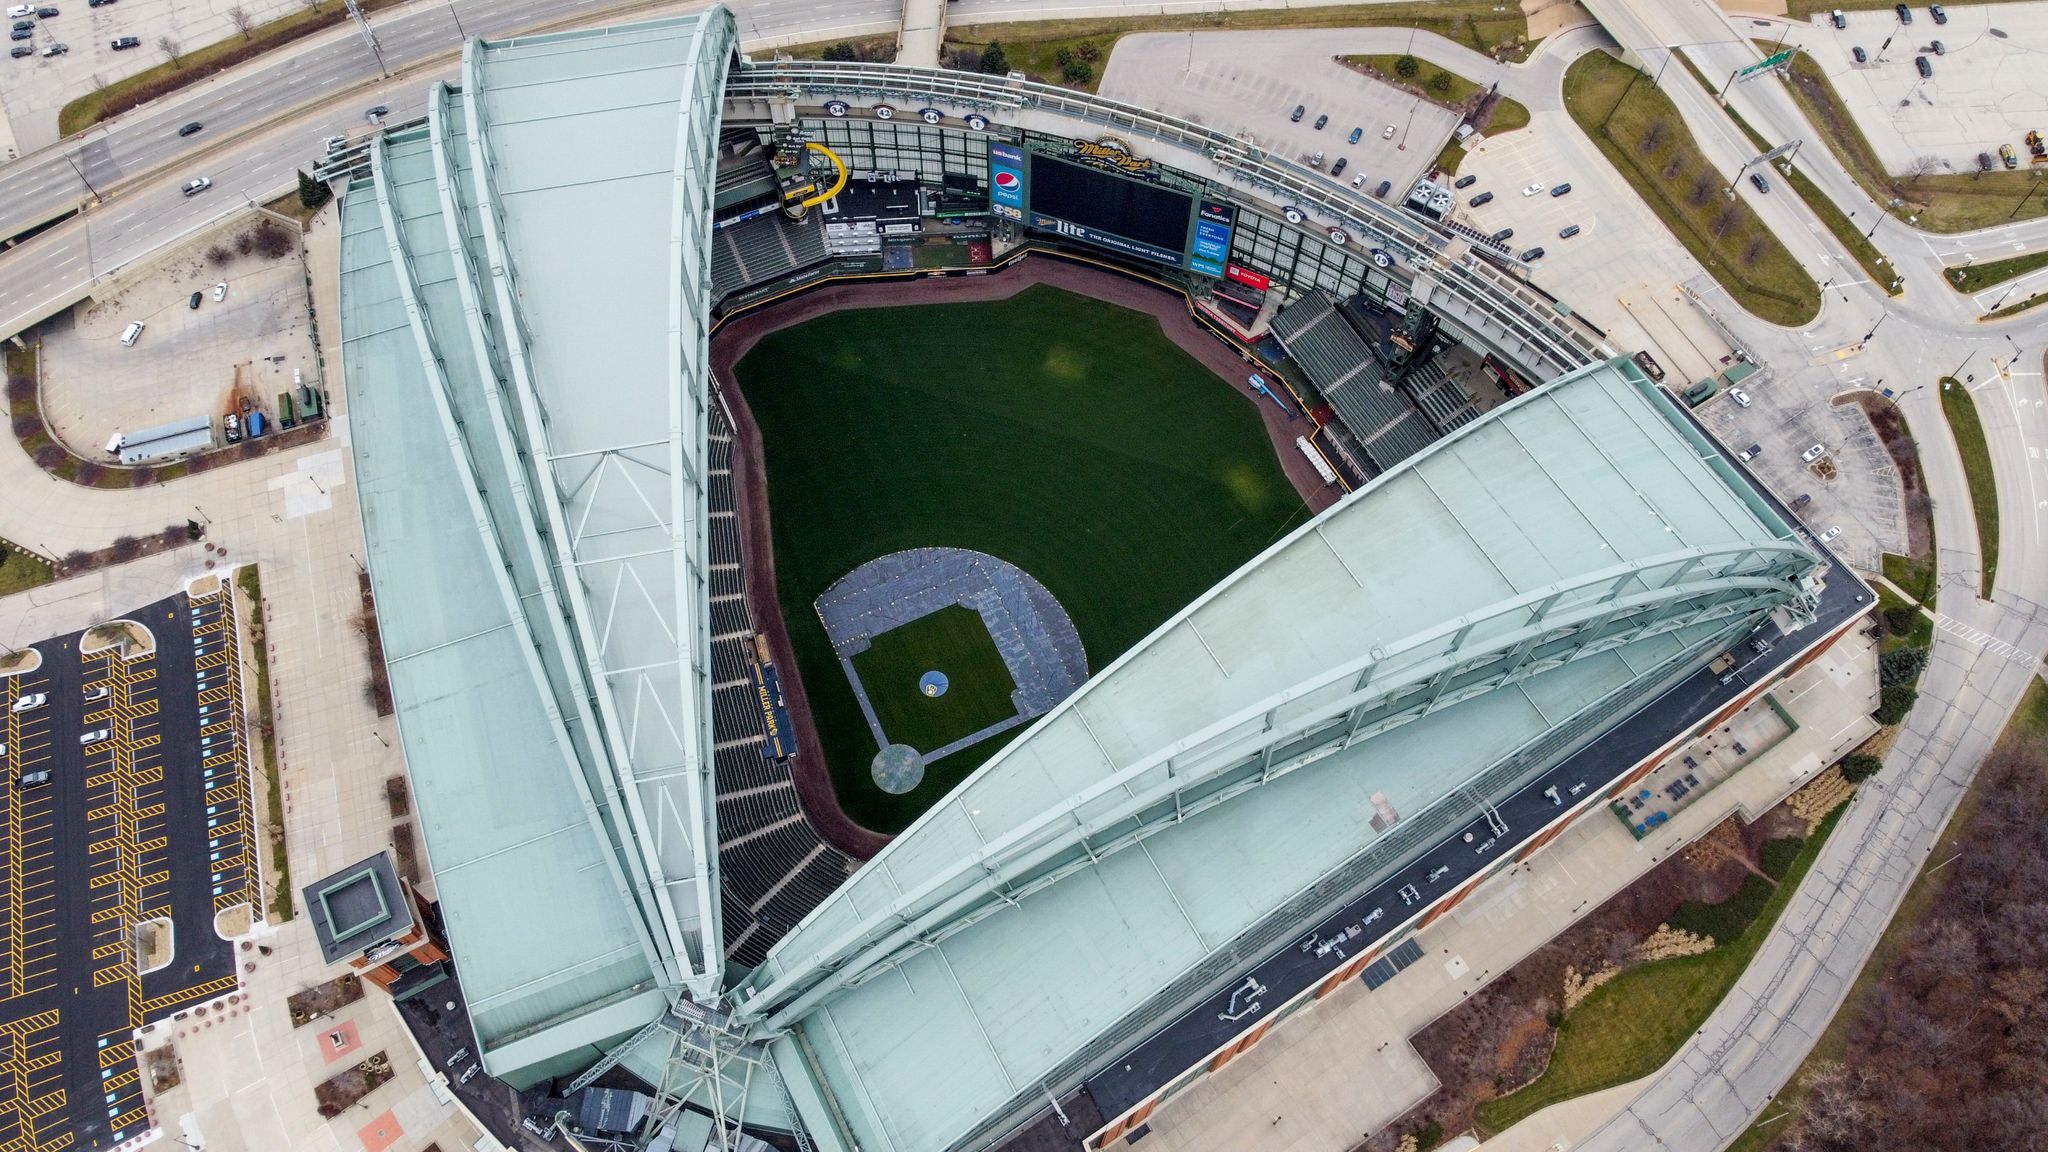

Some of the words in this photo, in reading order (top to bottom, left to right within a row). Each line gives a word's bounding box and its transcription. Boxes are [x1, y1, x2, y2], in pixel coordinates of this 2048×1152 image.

[1074, 140, 1122, 158] Miller
[1116, 154, 1151, 171] Park
[997, 190, 1019, 201] pepsi
[1004, 206, 1022, 219] 58
[1200, 210, 1230, 223] Fanatics
[1056, 220, 1086, 238] Lite
[1089, 233, 1102, 241] THE
[1102, 237, 1131, 249] ORIGINAL
[1131, 245, 1151, 254] LIGHT
[1240, 272, 1261, 283] TOYOTA
[758, 685, 771, 711] MILLER
[764, 710, 777, 730] PARK
